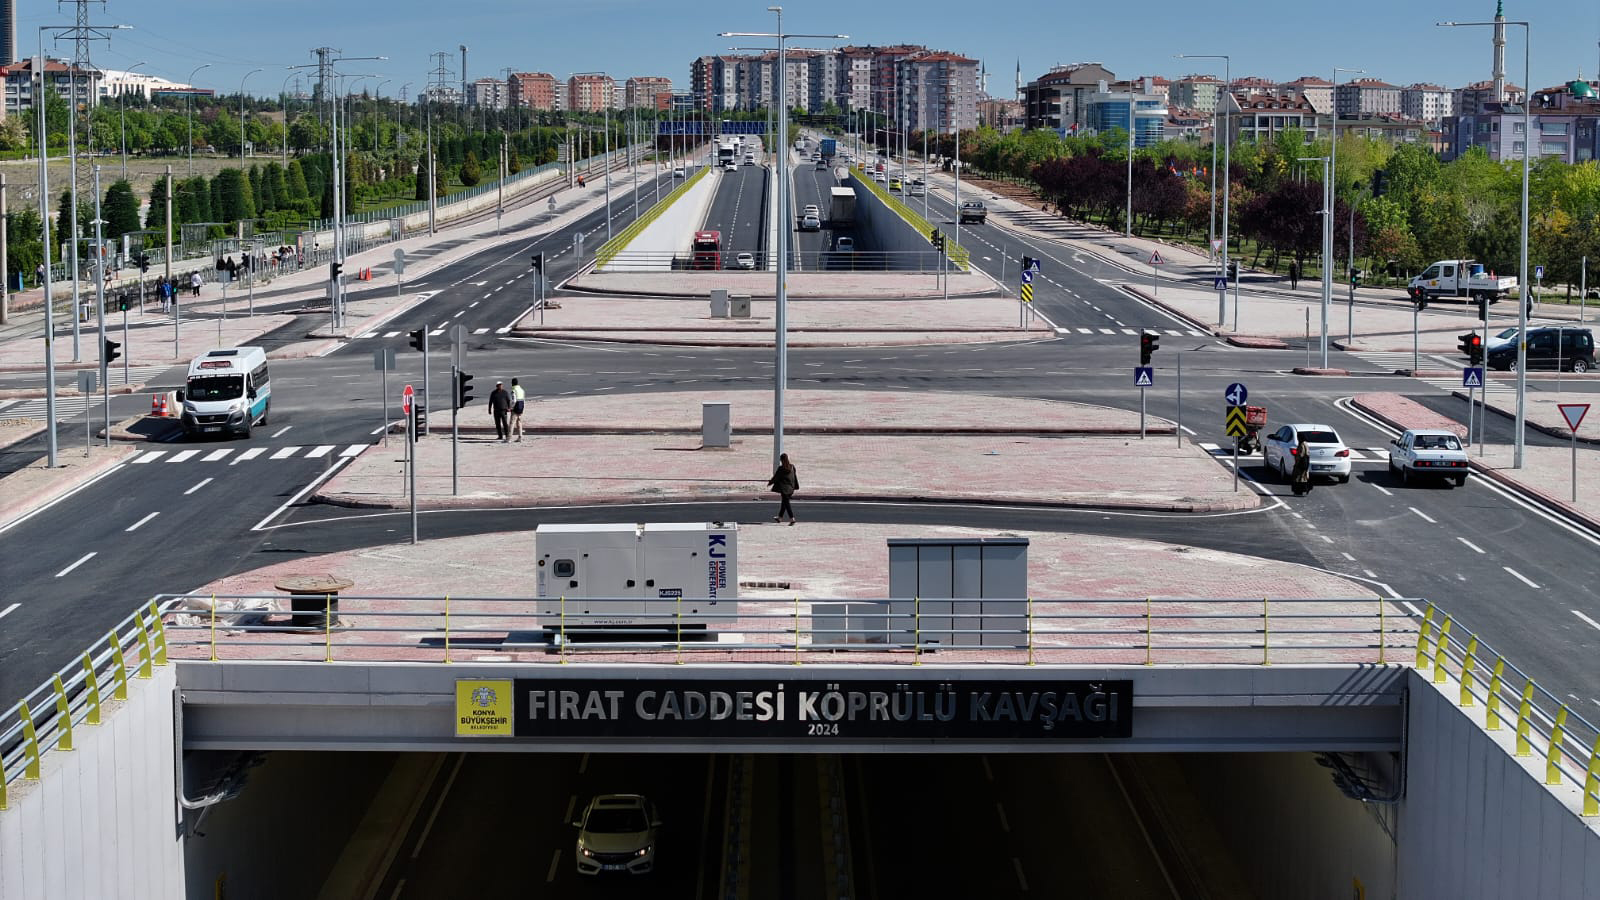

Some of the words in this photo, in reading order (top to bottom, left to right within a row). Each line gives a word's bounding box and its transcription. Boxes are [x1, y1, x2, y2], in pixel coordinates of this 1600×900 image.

[709, 534, 726, 558] KJ
[529, 690, 625, 721] FIRAT
[635, 683, 785, 721] CADDESİ
[799, 683, 958, 722] KÖPRÜLÜ
[970, 683, 1119, 731] KAVŞAĞI
[461, 716, 507, 724] BÜYÜKŞEHİR
[807, 724, 840, 736] 2024
